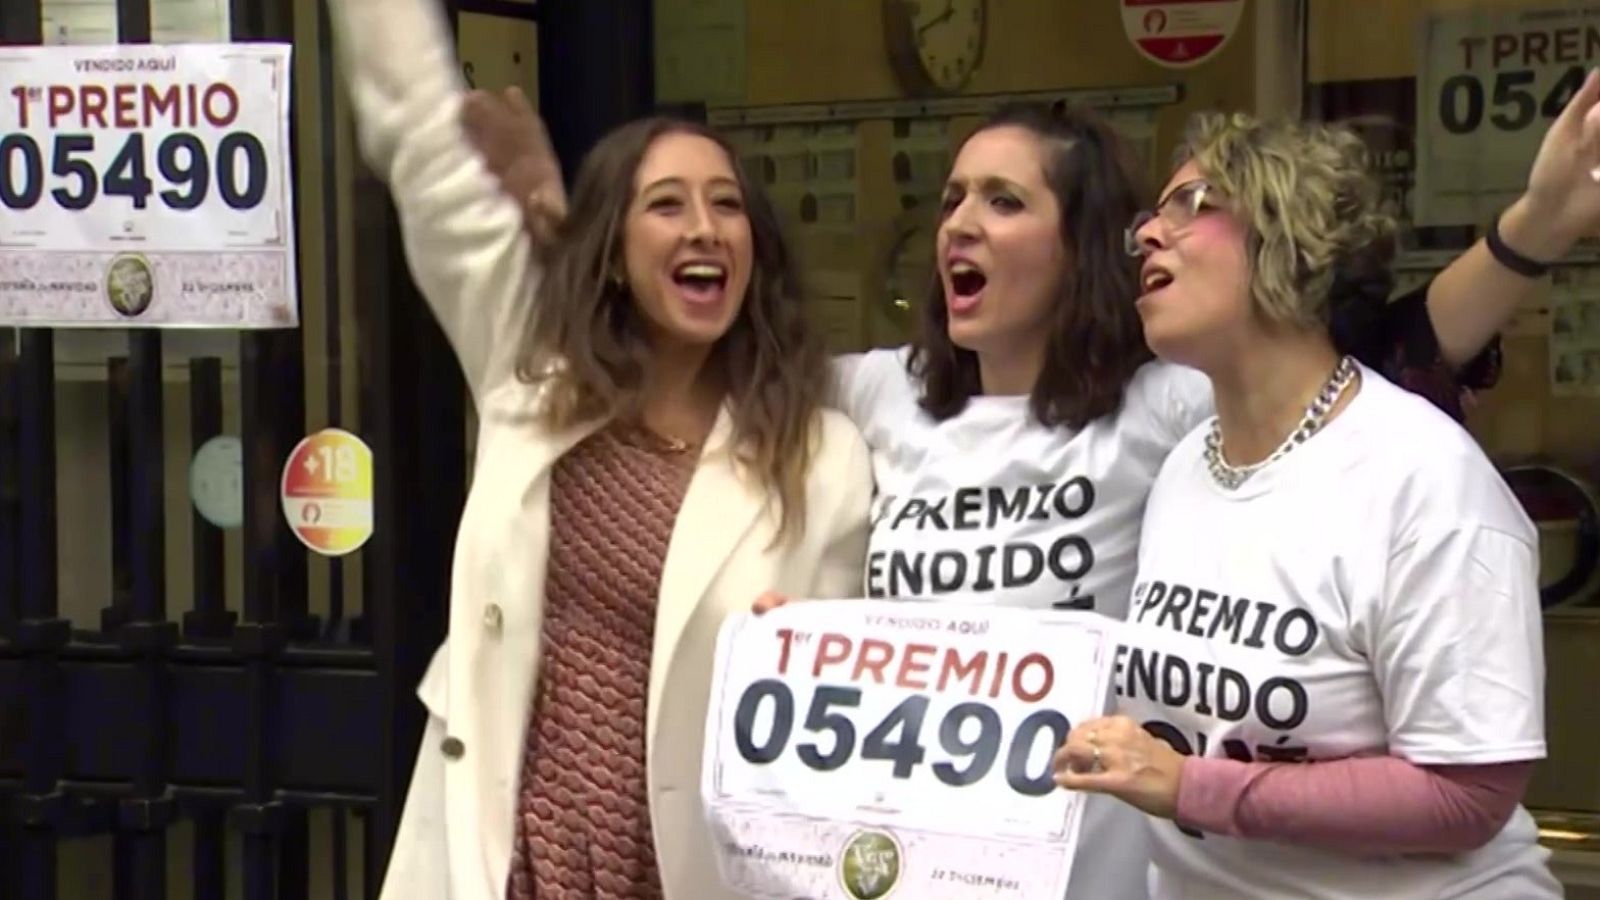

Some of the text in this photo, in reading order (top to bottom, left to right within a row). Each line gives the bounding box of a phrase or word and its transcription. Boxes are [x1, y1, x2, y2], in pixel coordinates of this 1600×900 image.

[74, 59, 135, 72] VENDIDO
[48, 82, 239, 129] PREMIO
[0, 132, 268, 210] 05490
[303, 445, 357, 483] +18
[1137, 580, 1318, 657] PREMIO
[812, 632, 1055, 703] PREMIO
[733, 678, 1072, 798] 05490
